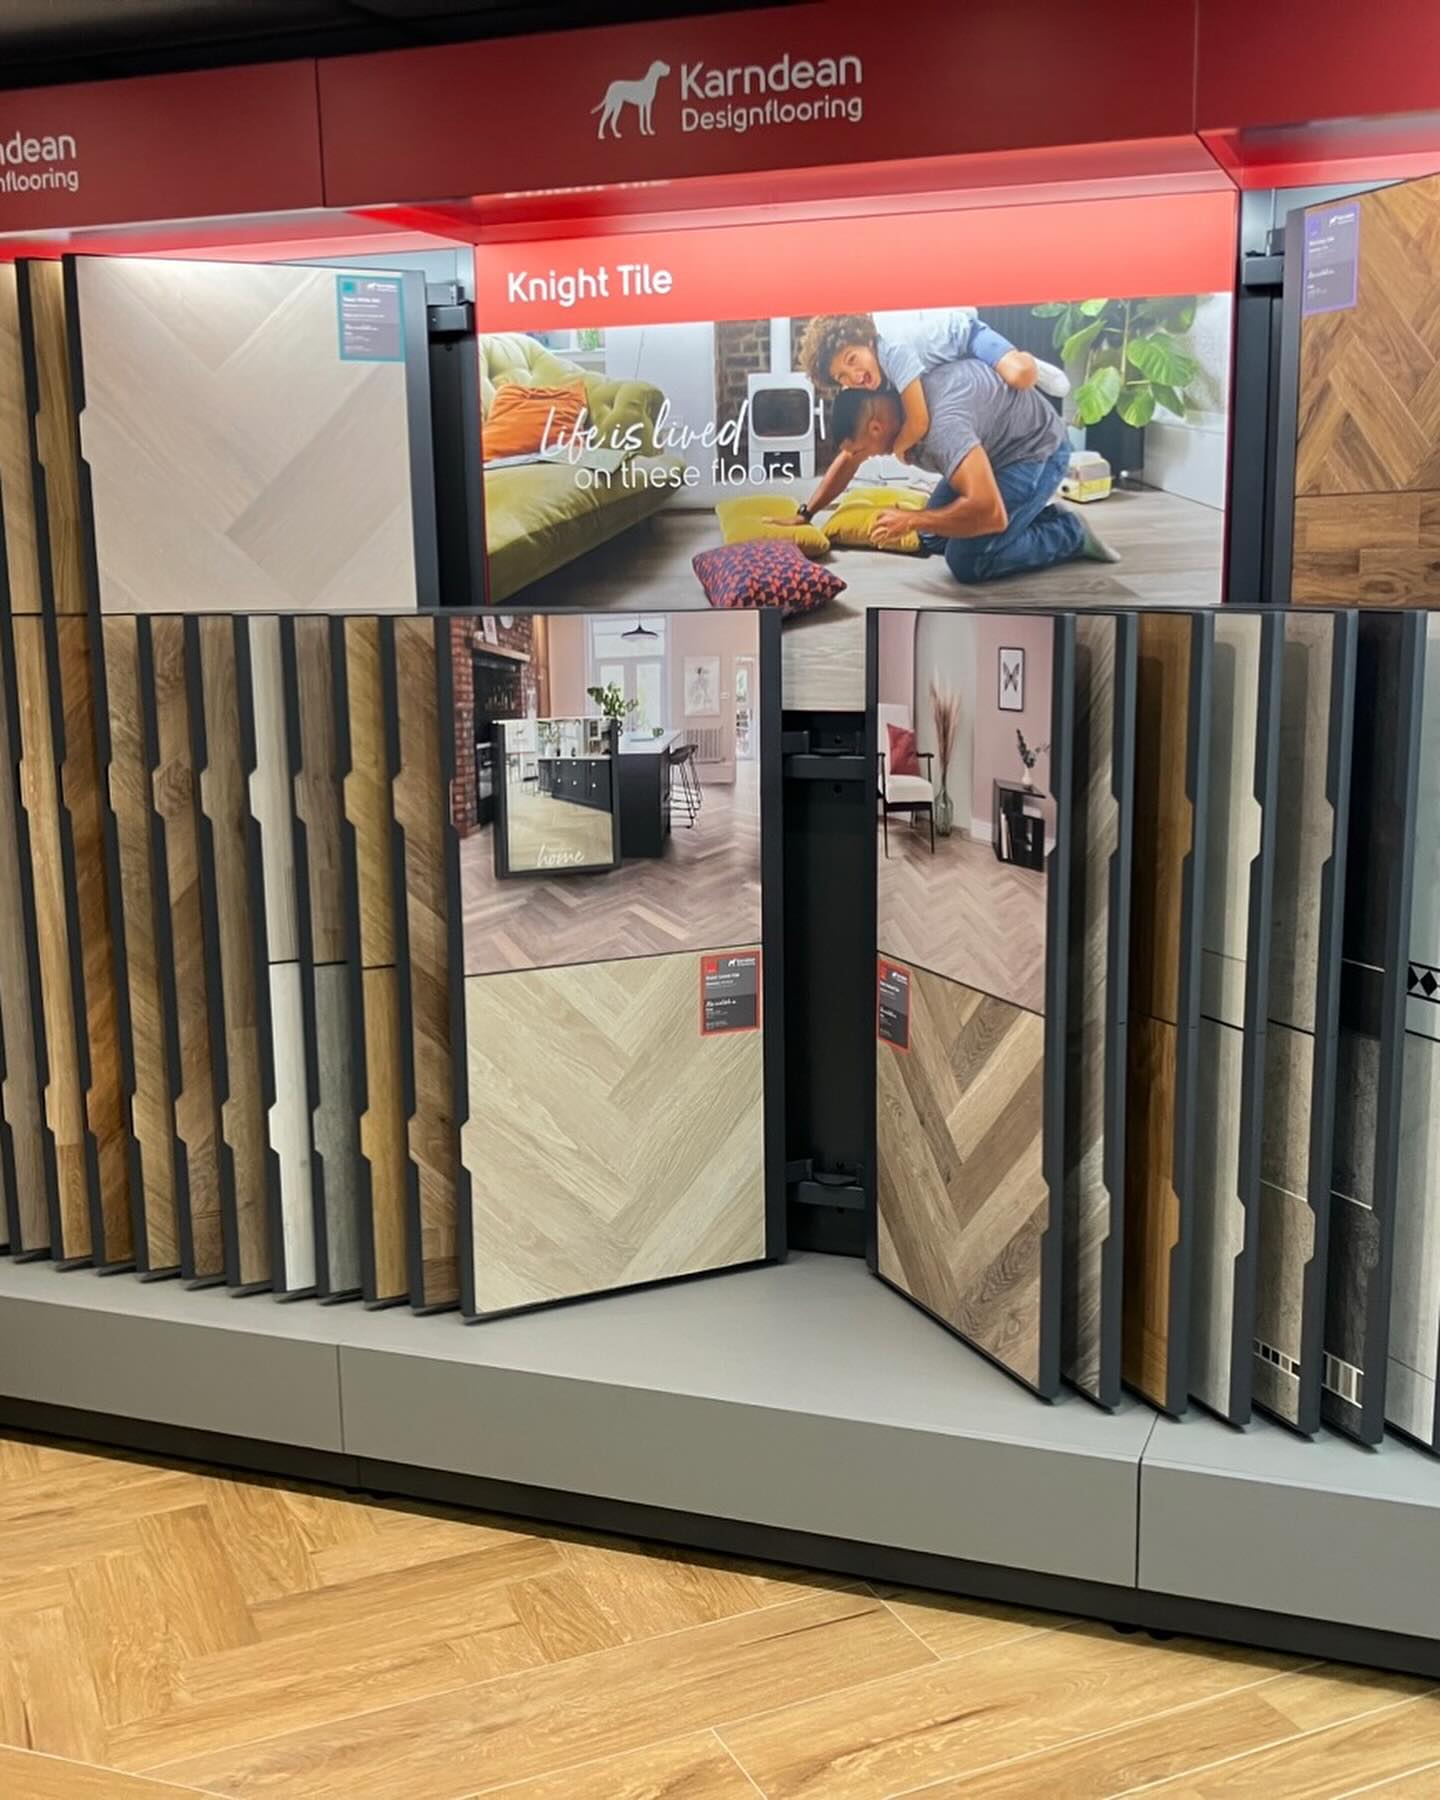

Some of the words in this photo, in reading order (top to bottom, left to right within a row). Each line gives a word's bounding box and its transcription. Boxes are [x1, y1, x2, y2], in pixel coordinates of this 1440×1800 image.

[680, 53, 863, 101] Karndean
[681, 94, 863, 133] Designflooring
[507, 265, 609, 307] Knight
[616, 263, 673, 296] Tile
[539, 405, 604, 464] Life
[609, 420, 645, 451] is
[652, 398, 750, 456] lived
[574, 467, 611, 489] on
[621, 461, 701, 489] these
[711, 457, 796, 486] floors
